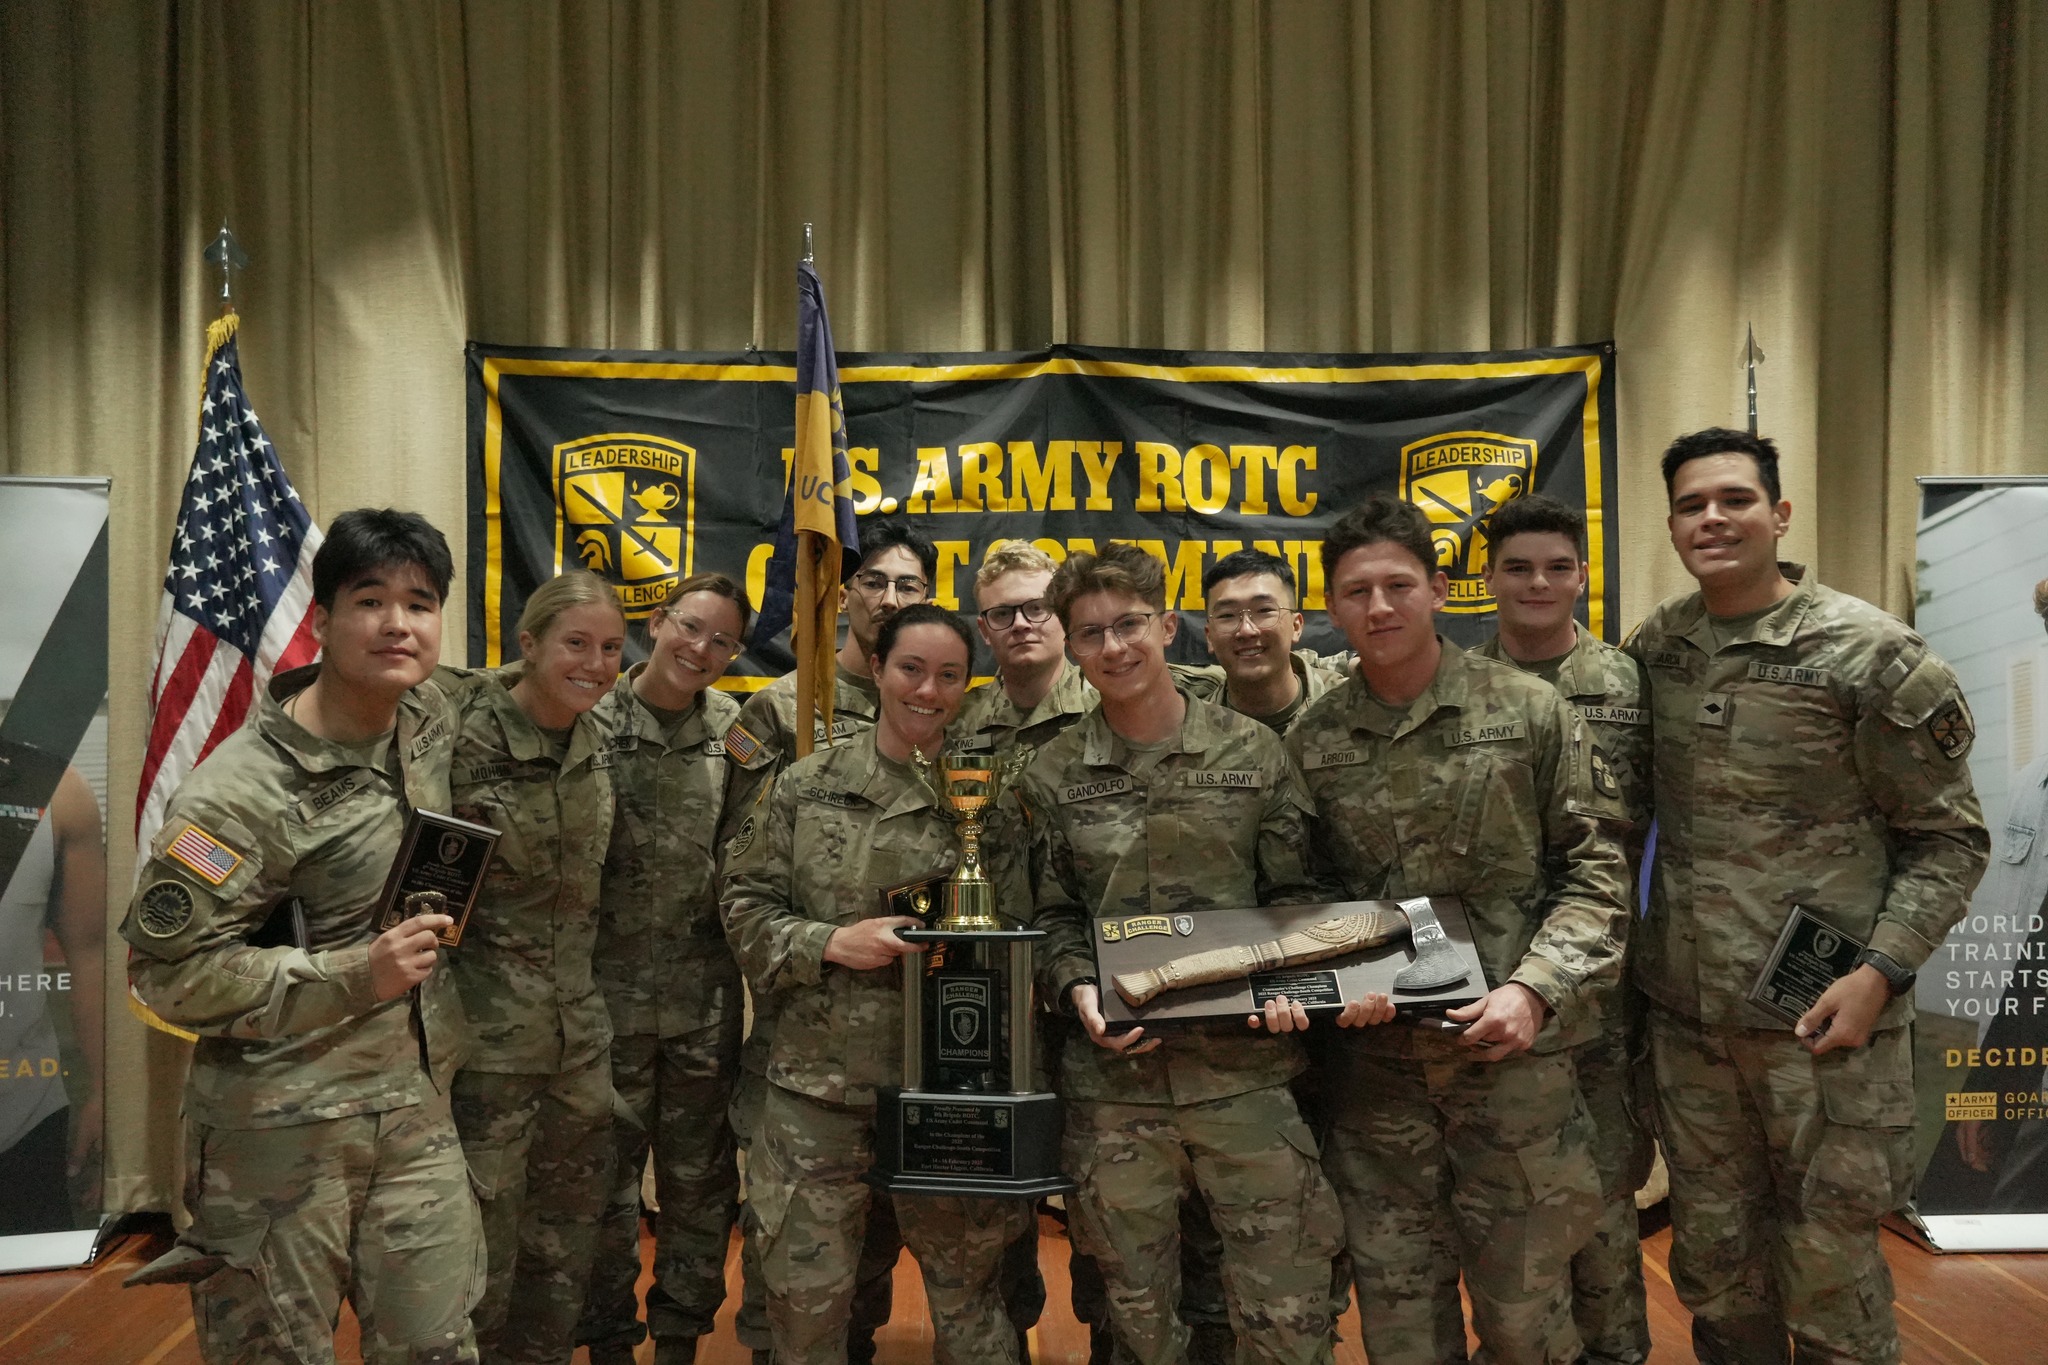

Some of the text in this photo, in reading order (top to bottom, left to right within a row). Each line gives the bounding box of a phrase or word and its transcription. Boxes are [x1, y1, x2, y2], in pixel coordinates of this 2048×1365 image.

[569, 449, 680, 471] LEADERSHIP
[1416, 447, 1523, 471] LEADERSHIP
[907, 441, 1122, 513] ARMY
[1136, 442, 1318, 516] ROTC
[1757, 664, 1822, 684] U.S. ARMY
[1585, 708, 1642, 722] U.S. ARMY
[1451, 725, 1515, 745] U.S. ARMY
[1320, 751, 1355, 766] ARROYO
[1067, 779, 1125, 800] GANDOLFO
[1196, 773, 1253, 786] U.S. ARMY
[312, 778, 356, 810] BEAMS
[1128, 925, 1168, 933] CHALLENGE
[1949, 914, 2044, 934] WORLD
[1946, 969, 2048, 989] STARTS
[1946, 997, 2018, 1017] YOUR
[941, 1048, 989, 1058] CHAMPIONS
[1963, 1094, 1995, 1105] ARMY
[1948, 1108, 1994, 1119] OFFICER
